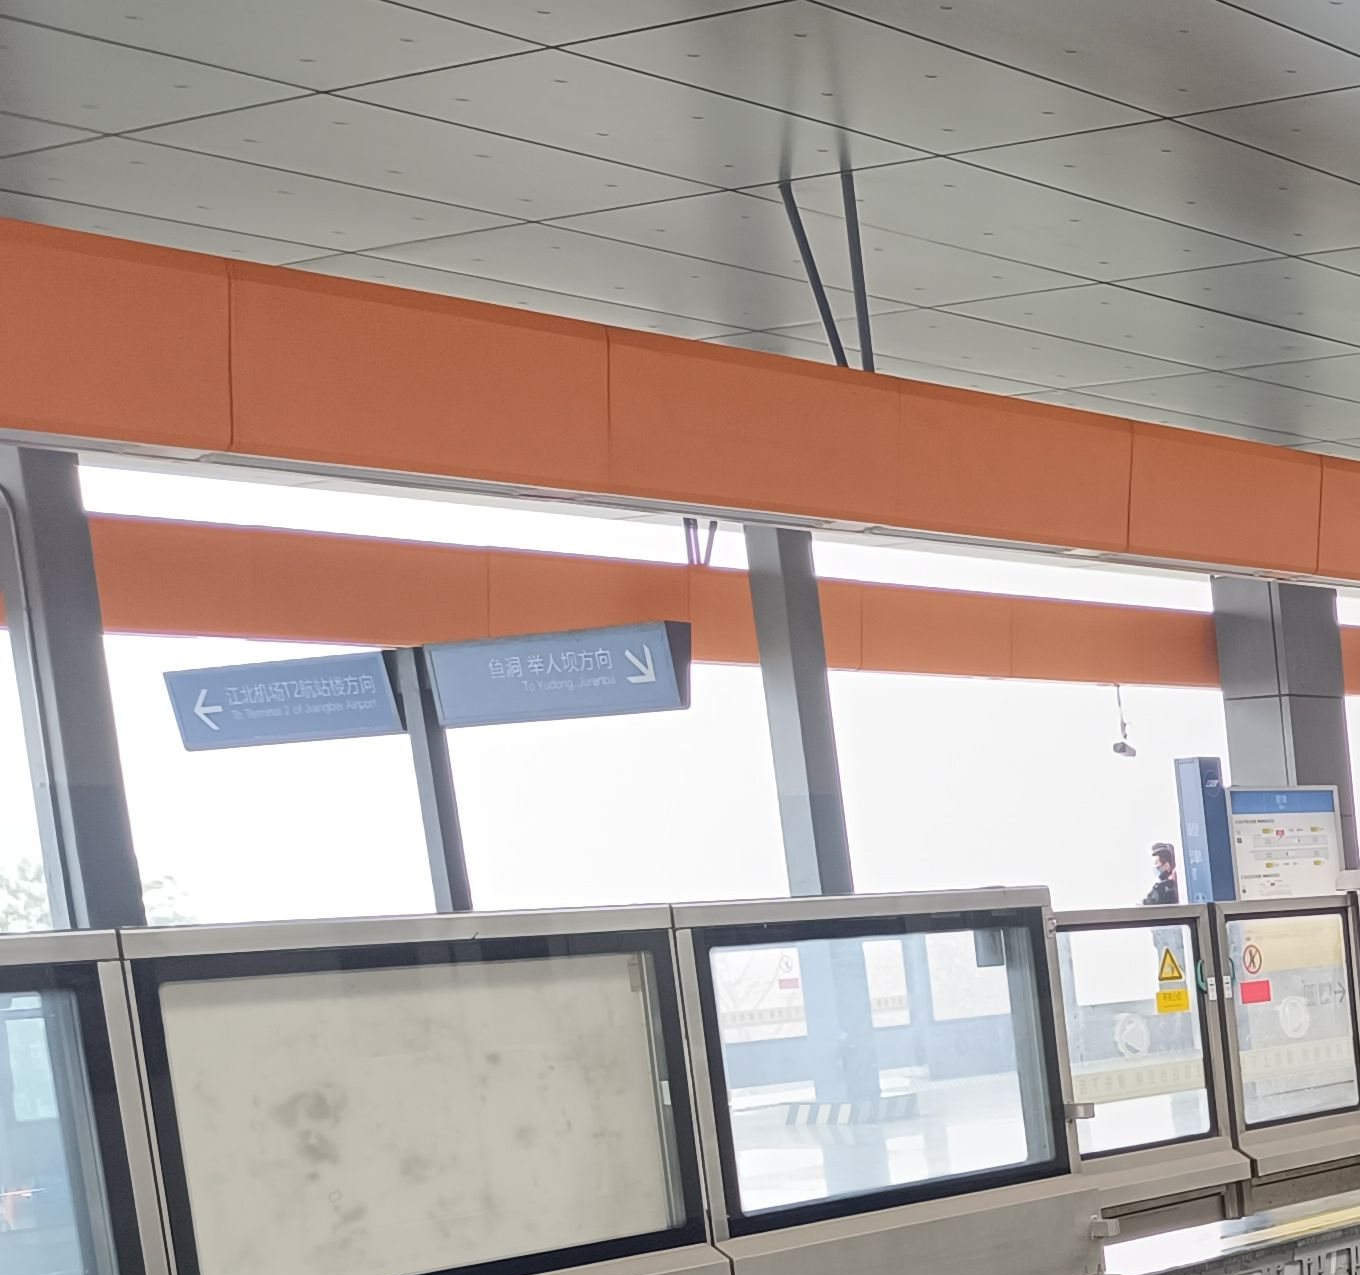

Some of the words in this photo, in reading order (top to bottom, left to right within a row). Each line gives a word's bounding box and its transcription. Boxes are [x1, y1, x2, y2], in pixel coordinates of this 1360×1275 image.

[527, 648, 614, 676] 举人坝方向
[521, 680, 536, 692] To
[283, 704, 291, 716] 2
[345, 698, 378, 711] Airport
